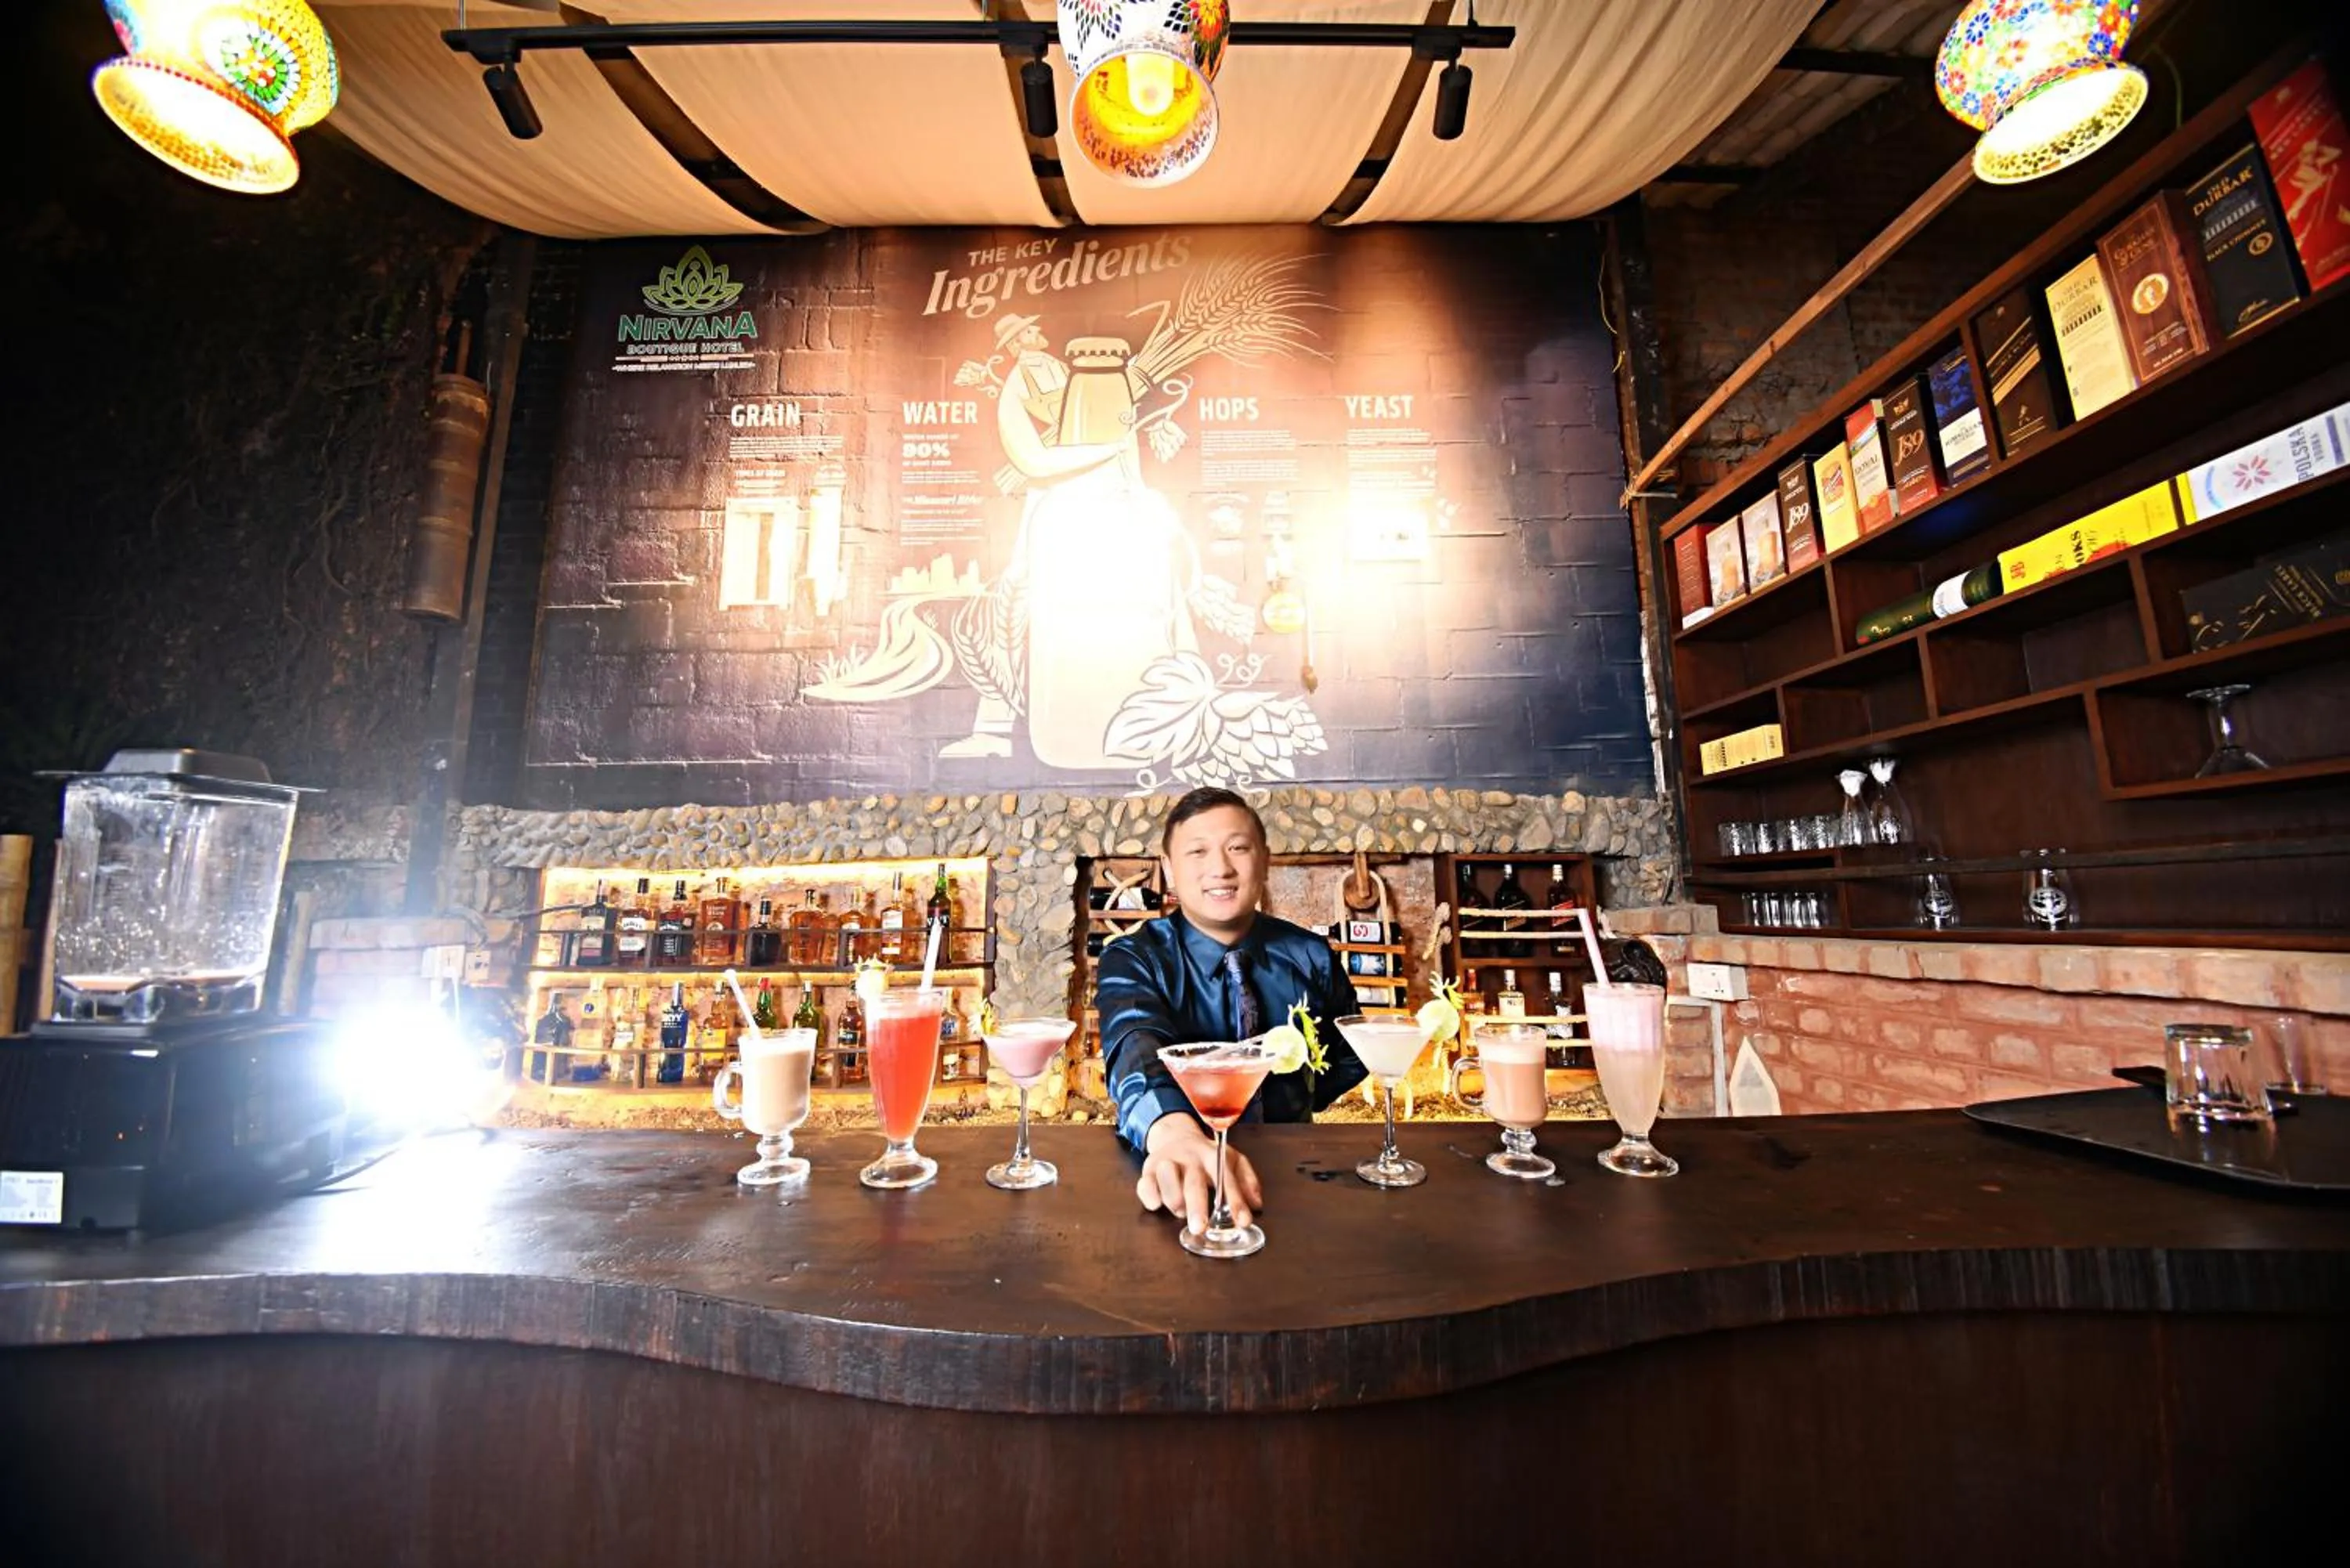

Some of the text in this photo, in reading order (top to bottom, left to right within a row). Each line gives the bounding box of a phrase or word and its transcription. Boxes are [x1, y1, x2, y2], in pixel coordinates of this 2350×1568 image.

[968, 238, 1058, 267] THE KEY
[921, 231, 1192, 319] Ingredients
[618, 312, 757, 341] NIRVANA
[626, 341, 744, 355] BOUTIQUE HOTEL
[731, 401, 801, 427] GRAIN
[902, 400, 978, 425] WATER
[1198, 397, 1260, 421] HOPS
[1344, 395, 1413, 419] YEAST
[902, 443, 951, 458] 90%
[2288, 426, 2316, 482] POLSKA
